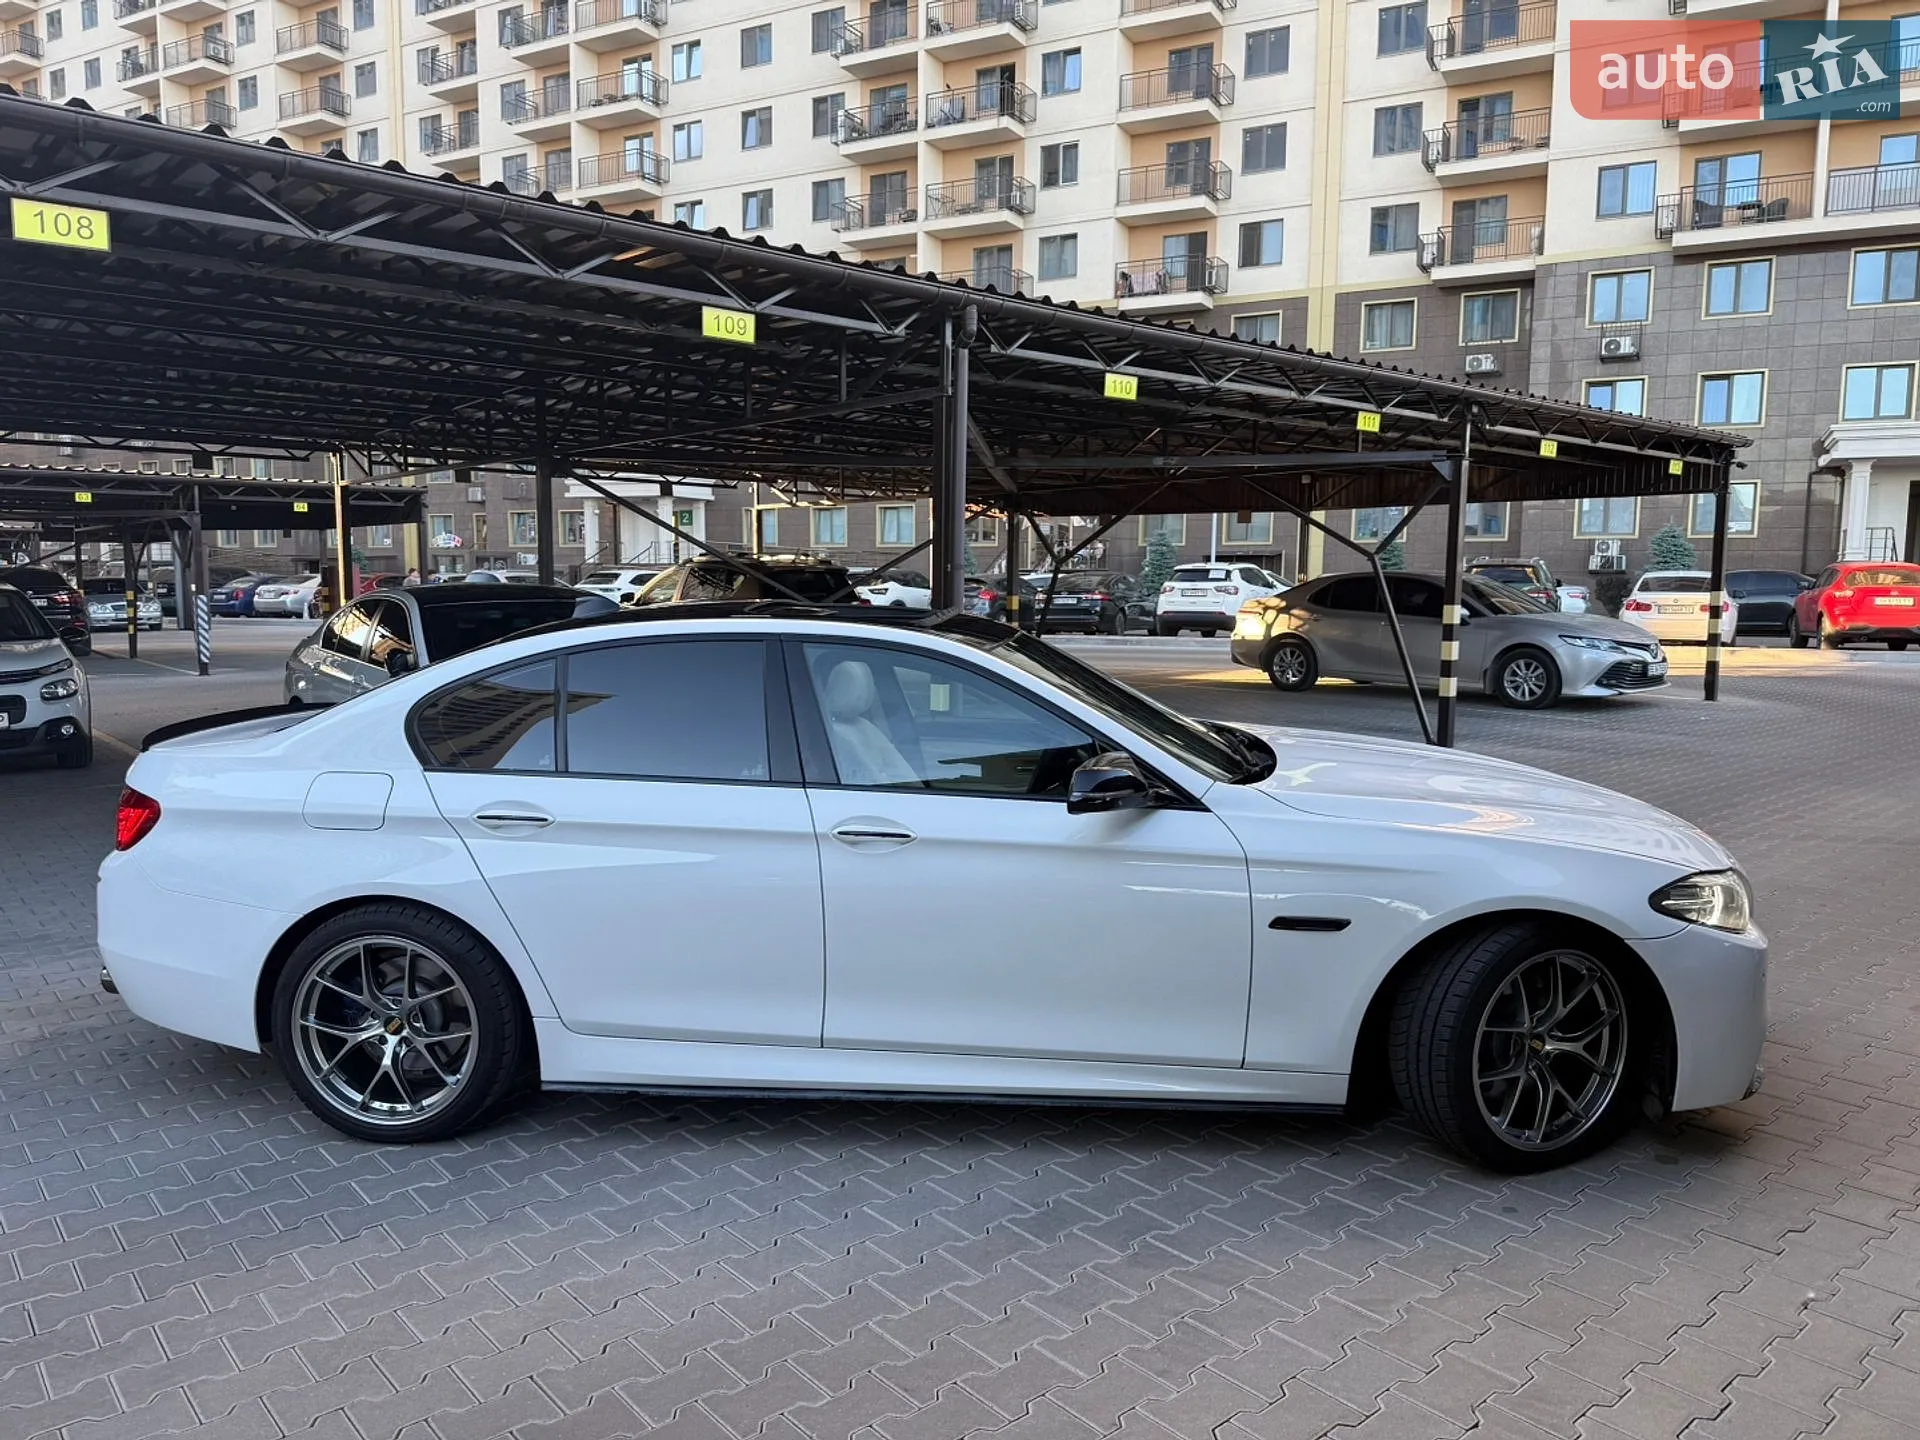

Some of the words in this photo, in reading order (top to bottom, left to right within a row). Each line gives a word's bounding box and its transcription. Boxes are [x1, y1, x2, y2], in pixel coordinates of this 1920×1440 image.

[33, 209, 94, 240] 108
[713, 314, 747, 336] 109
[1111, 379, 1132, 395] 110
[1362, 415, 1376, 428] 111
[682, 512, 689, 523] 2
